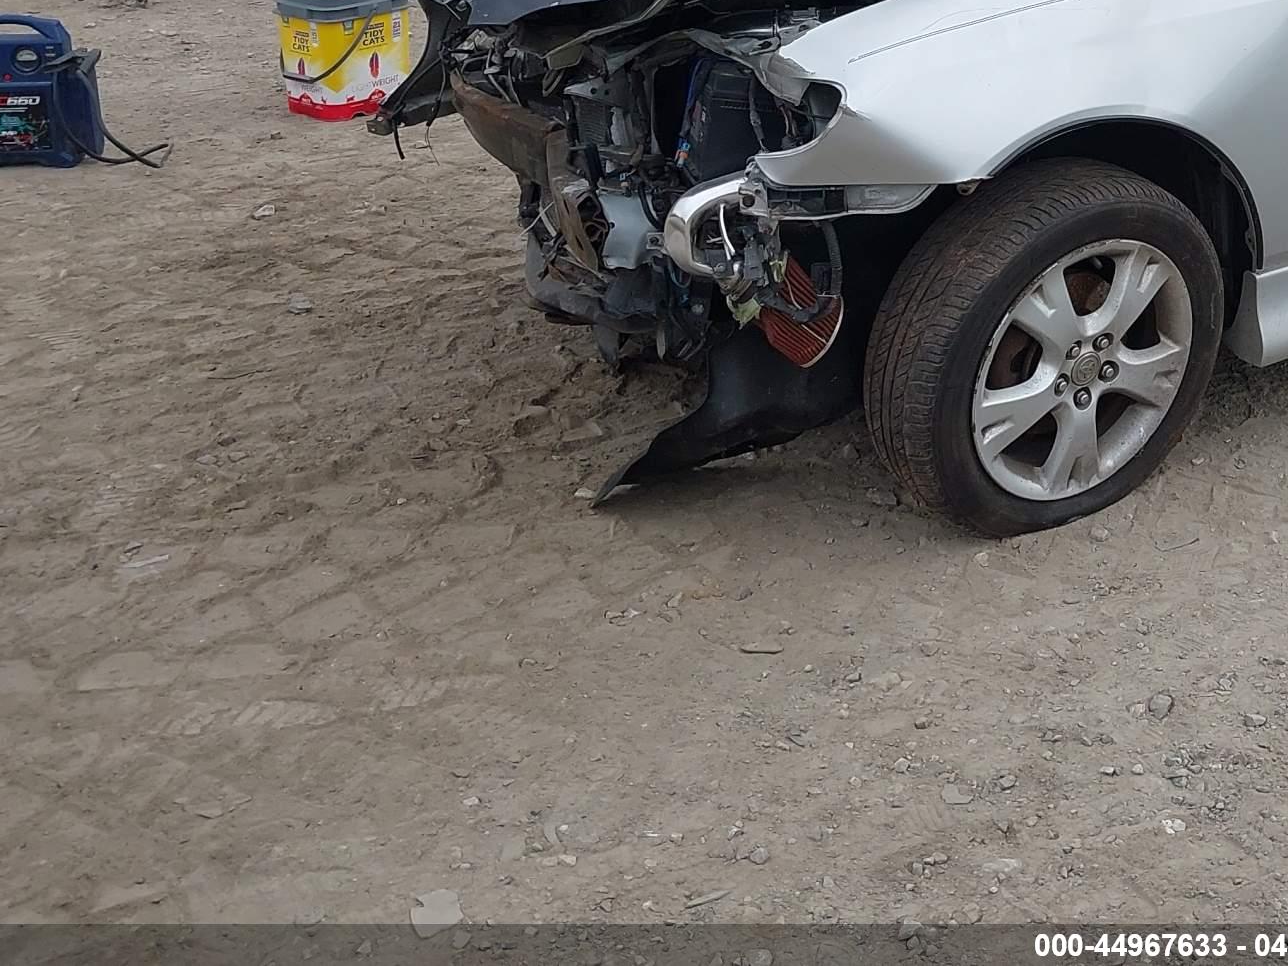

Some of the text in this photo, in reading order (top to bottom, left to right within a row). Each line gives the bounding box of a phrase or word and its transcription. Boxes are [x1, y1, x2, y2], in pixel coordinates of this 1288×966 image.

[364, 29, 385, 39] TIDY
[293, 35, 309, 45] TIDY
[363, 36, 385, 47] CATS
[292, 44, 310, 53] CATS
